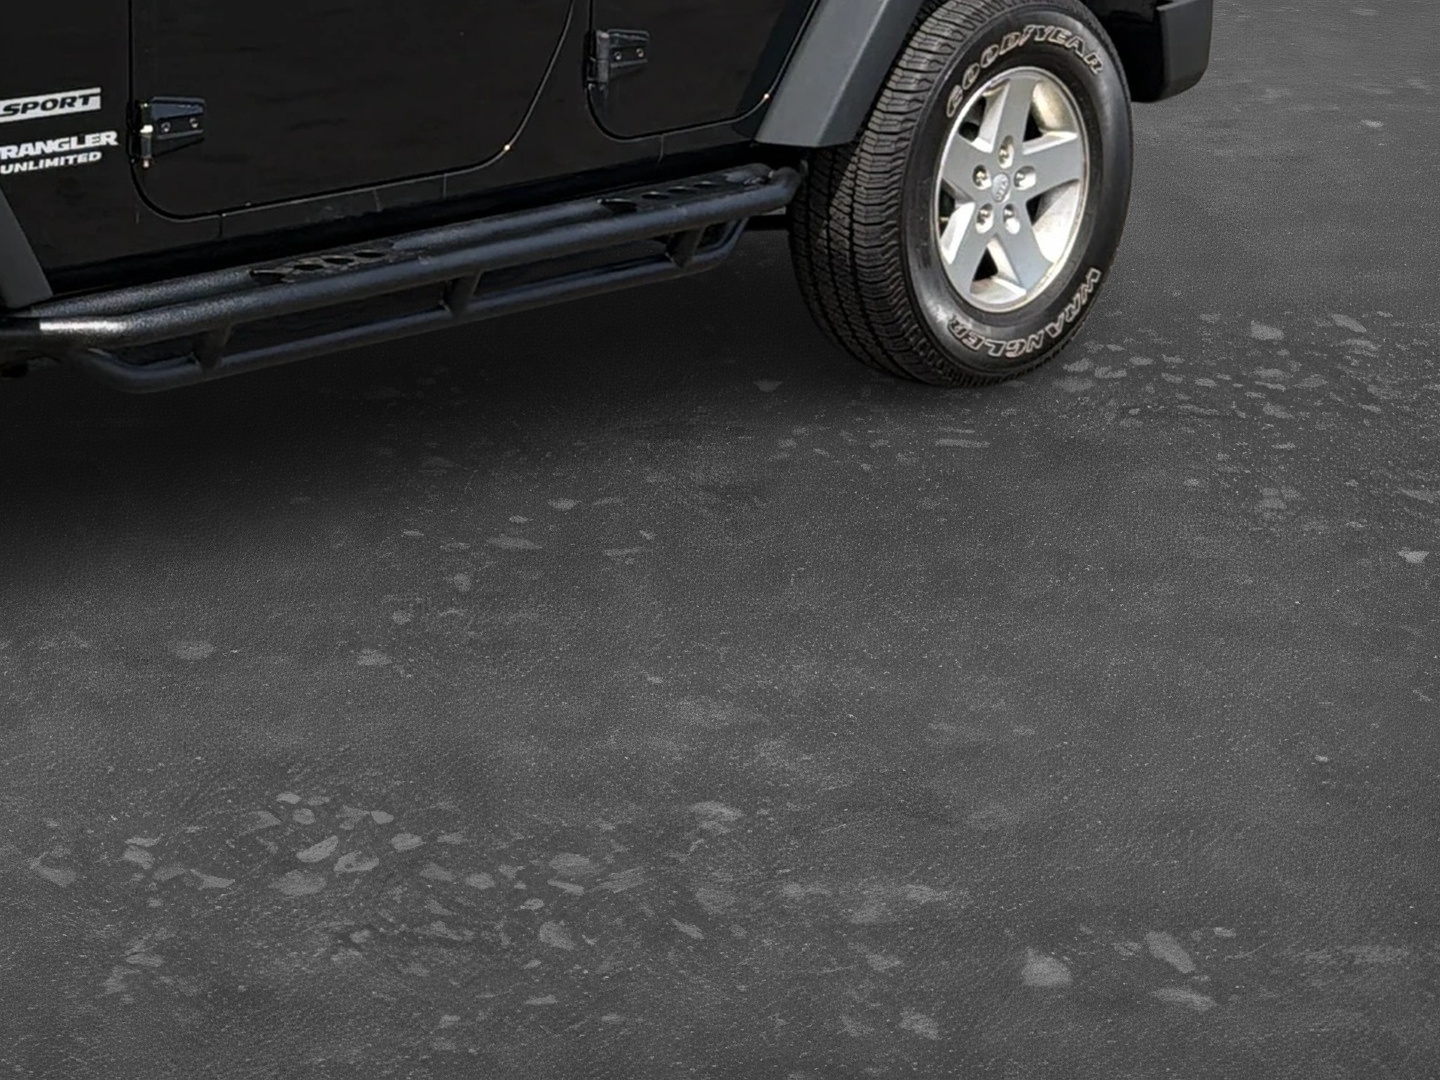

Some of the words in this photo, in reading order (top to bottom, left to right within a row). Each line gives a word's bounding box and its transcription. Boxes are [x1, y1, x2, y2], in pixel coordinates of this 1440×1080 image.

[946, 23, 1104, 118] GOODYEAR
[0, 93, 97, 118] SPORT
[0, 151, 103, 175] UNLIMITED
[947, 267, 1102, 359] WRANGLER
